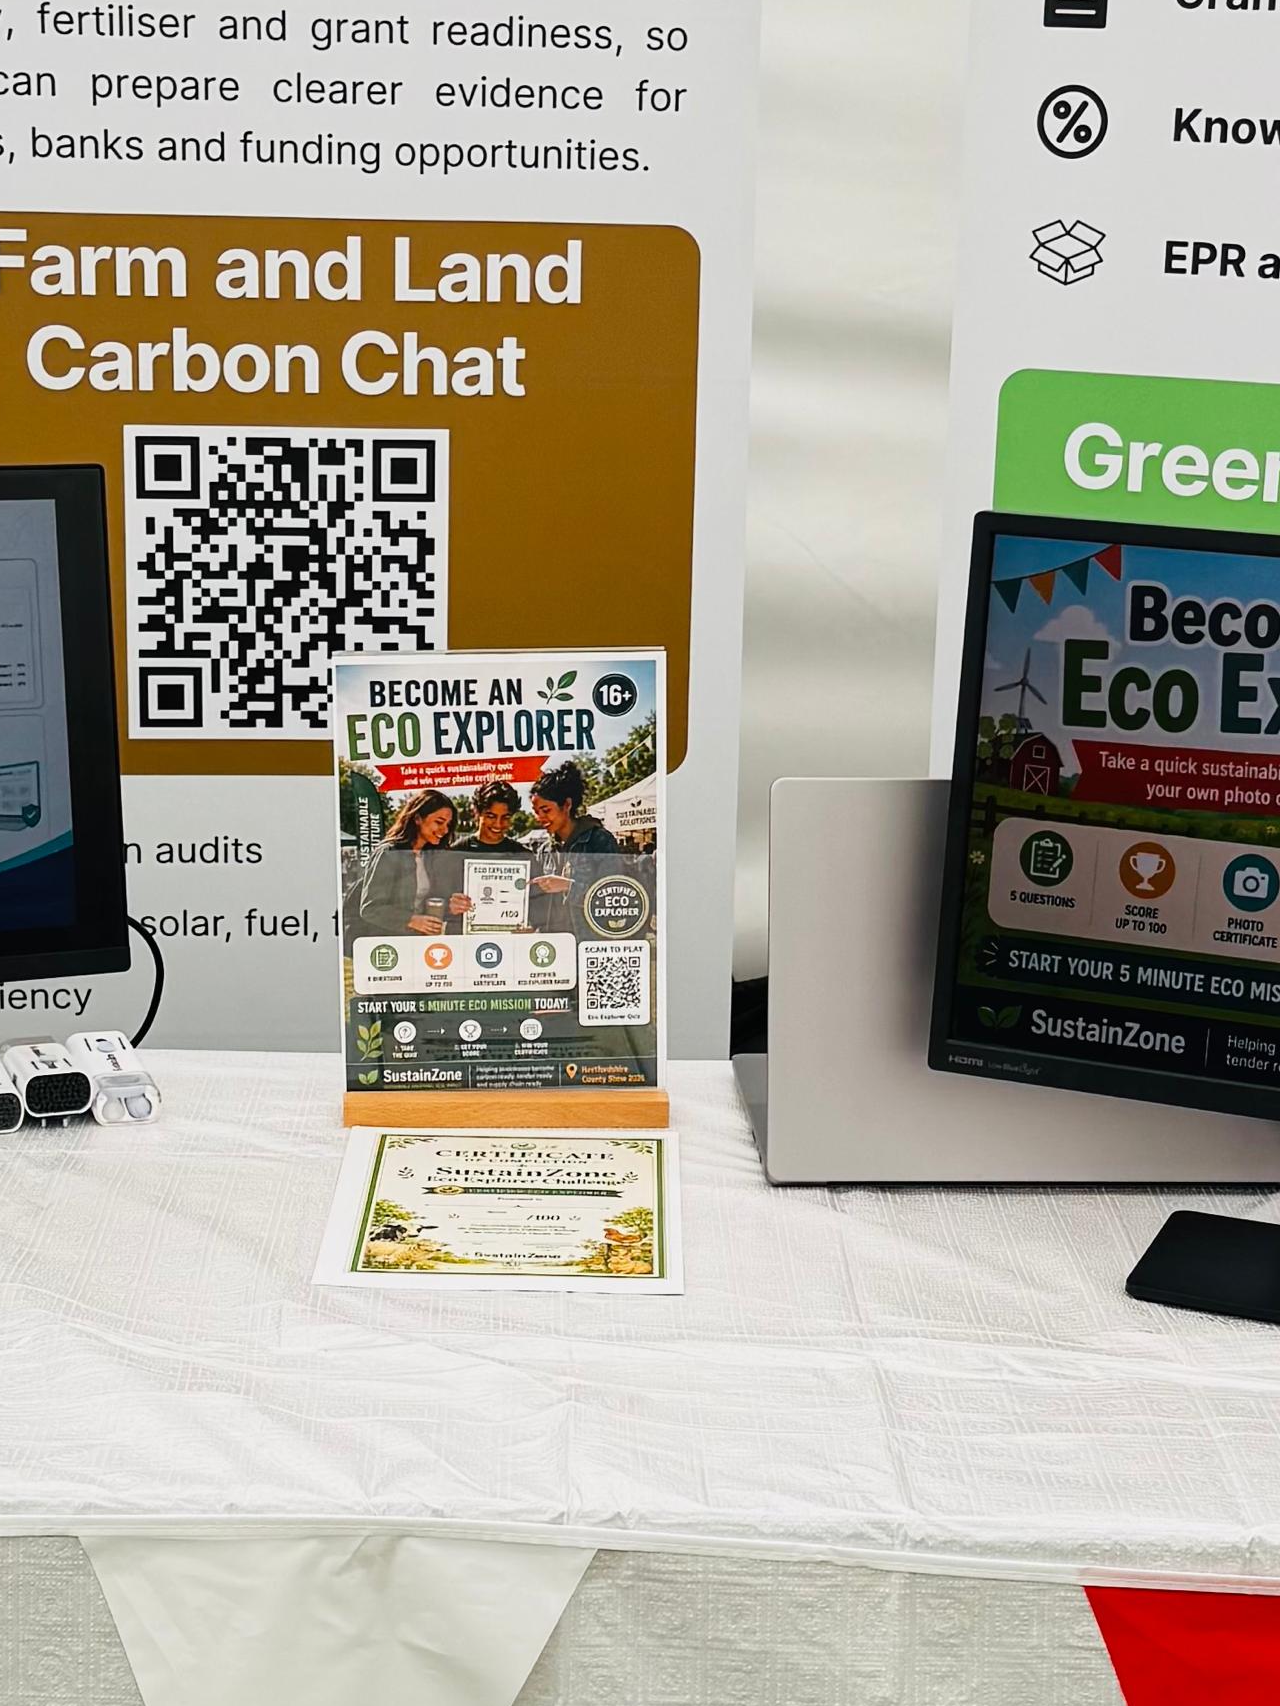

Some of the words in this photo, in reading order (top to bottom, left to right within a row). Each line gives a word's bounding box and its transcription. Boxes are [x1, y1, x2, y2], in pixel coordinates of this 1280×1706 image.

[216, 235, 362, 302] and
[393, 237, 582, 305] Land
[1163, 241, 1245, 278] EPR
[25, 325, 320, 394] Carbon
[340, 329, 526, 397] Chat
[370, 679, 478, 707] BECOME
[488, 678, 522, 705] AN
[599, 684, 631, 707] 16+
[1063, 639, 1198, 734] Eco
[346, 712, 420, 761] ECO
[433, 709, 595, 755] EXPLORER
[1099, 751, 1135, 771] Take
[1139, 757, 1148, 771] a
[1154, 754, 1197, 778] quick
[1146, 780, 1181, 801] your
[1186, 784, 1219, 800] own
[1224, 784, 1270, 808] photo
[156, 835, 263, 865] audits
[1010, 890, 1017, 903] 5
[1019, 891, 1075, 909] QUESTIONS
[1124, 904, 1159, 919] SCORE
[140, 908, 232, 943] solar,
[244, 909, 319, 941] fuel,
[1115, 917, 1128, 931] UP
[1131, 919, 1145, 931] TO
[1147, 921, 1167, 934] 100
[1009, 950, 1061, 975] START
[1067, 956, 1113, 981] YOUR
[1120, 962, 1130, 982] 5
[1136, 966, 1203, 993] MINUTE
[1210, 976, 1243, 998] ECO
[1031, 1009, 1186, 1055] SustainZone
[383, 1068, 462, 1083] SustainZone
